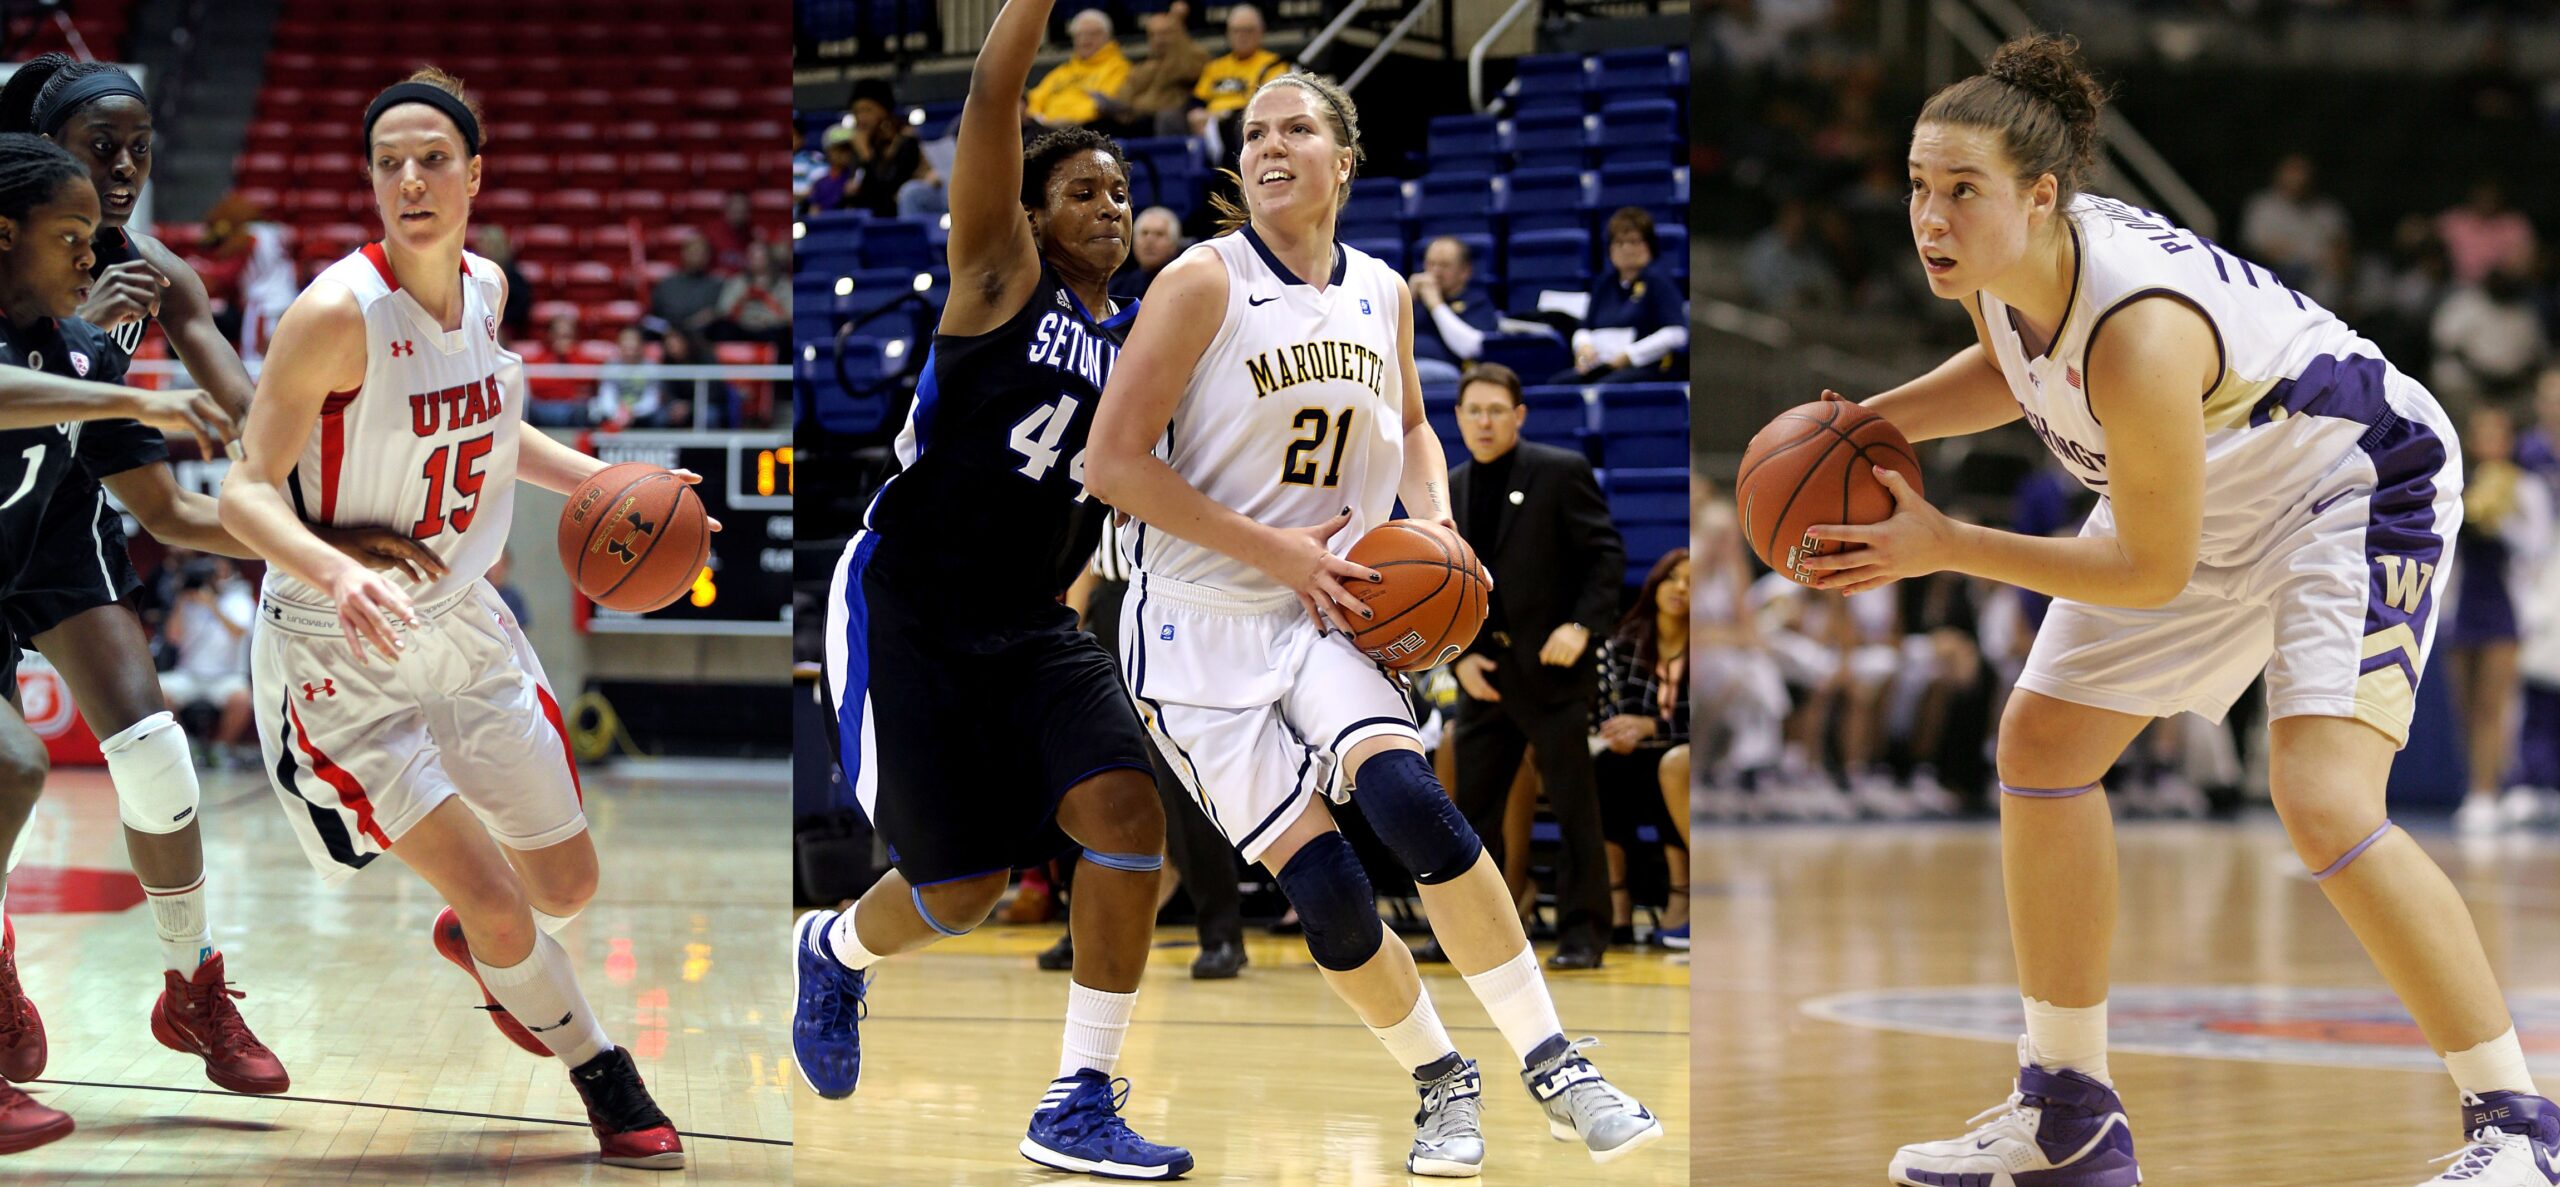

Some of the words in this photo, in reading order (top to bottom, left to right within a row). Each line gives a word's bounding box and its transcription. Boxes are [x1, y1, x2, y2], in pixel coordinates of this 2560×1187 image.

[1246, 341, 1383, 398] MARQUETTE
[409, 373, 502, 437] UTAH
[1280, 406, 1355, 489] 21
[412, 431, 494, 540] 15
[2374, 554, 2435, 615] W
[286, 613, 335, 629] ARMOUR
[2474, 1106, 2512, 1124] ELITE
